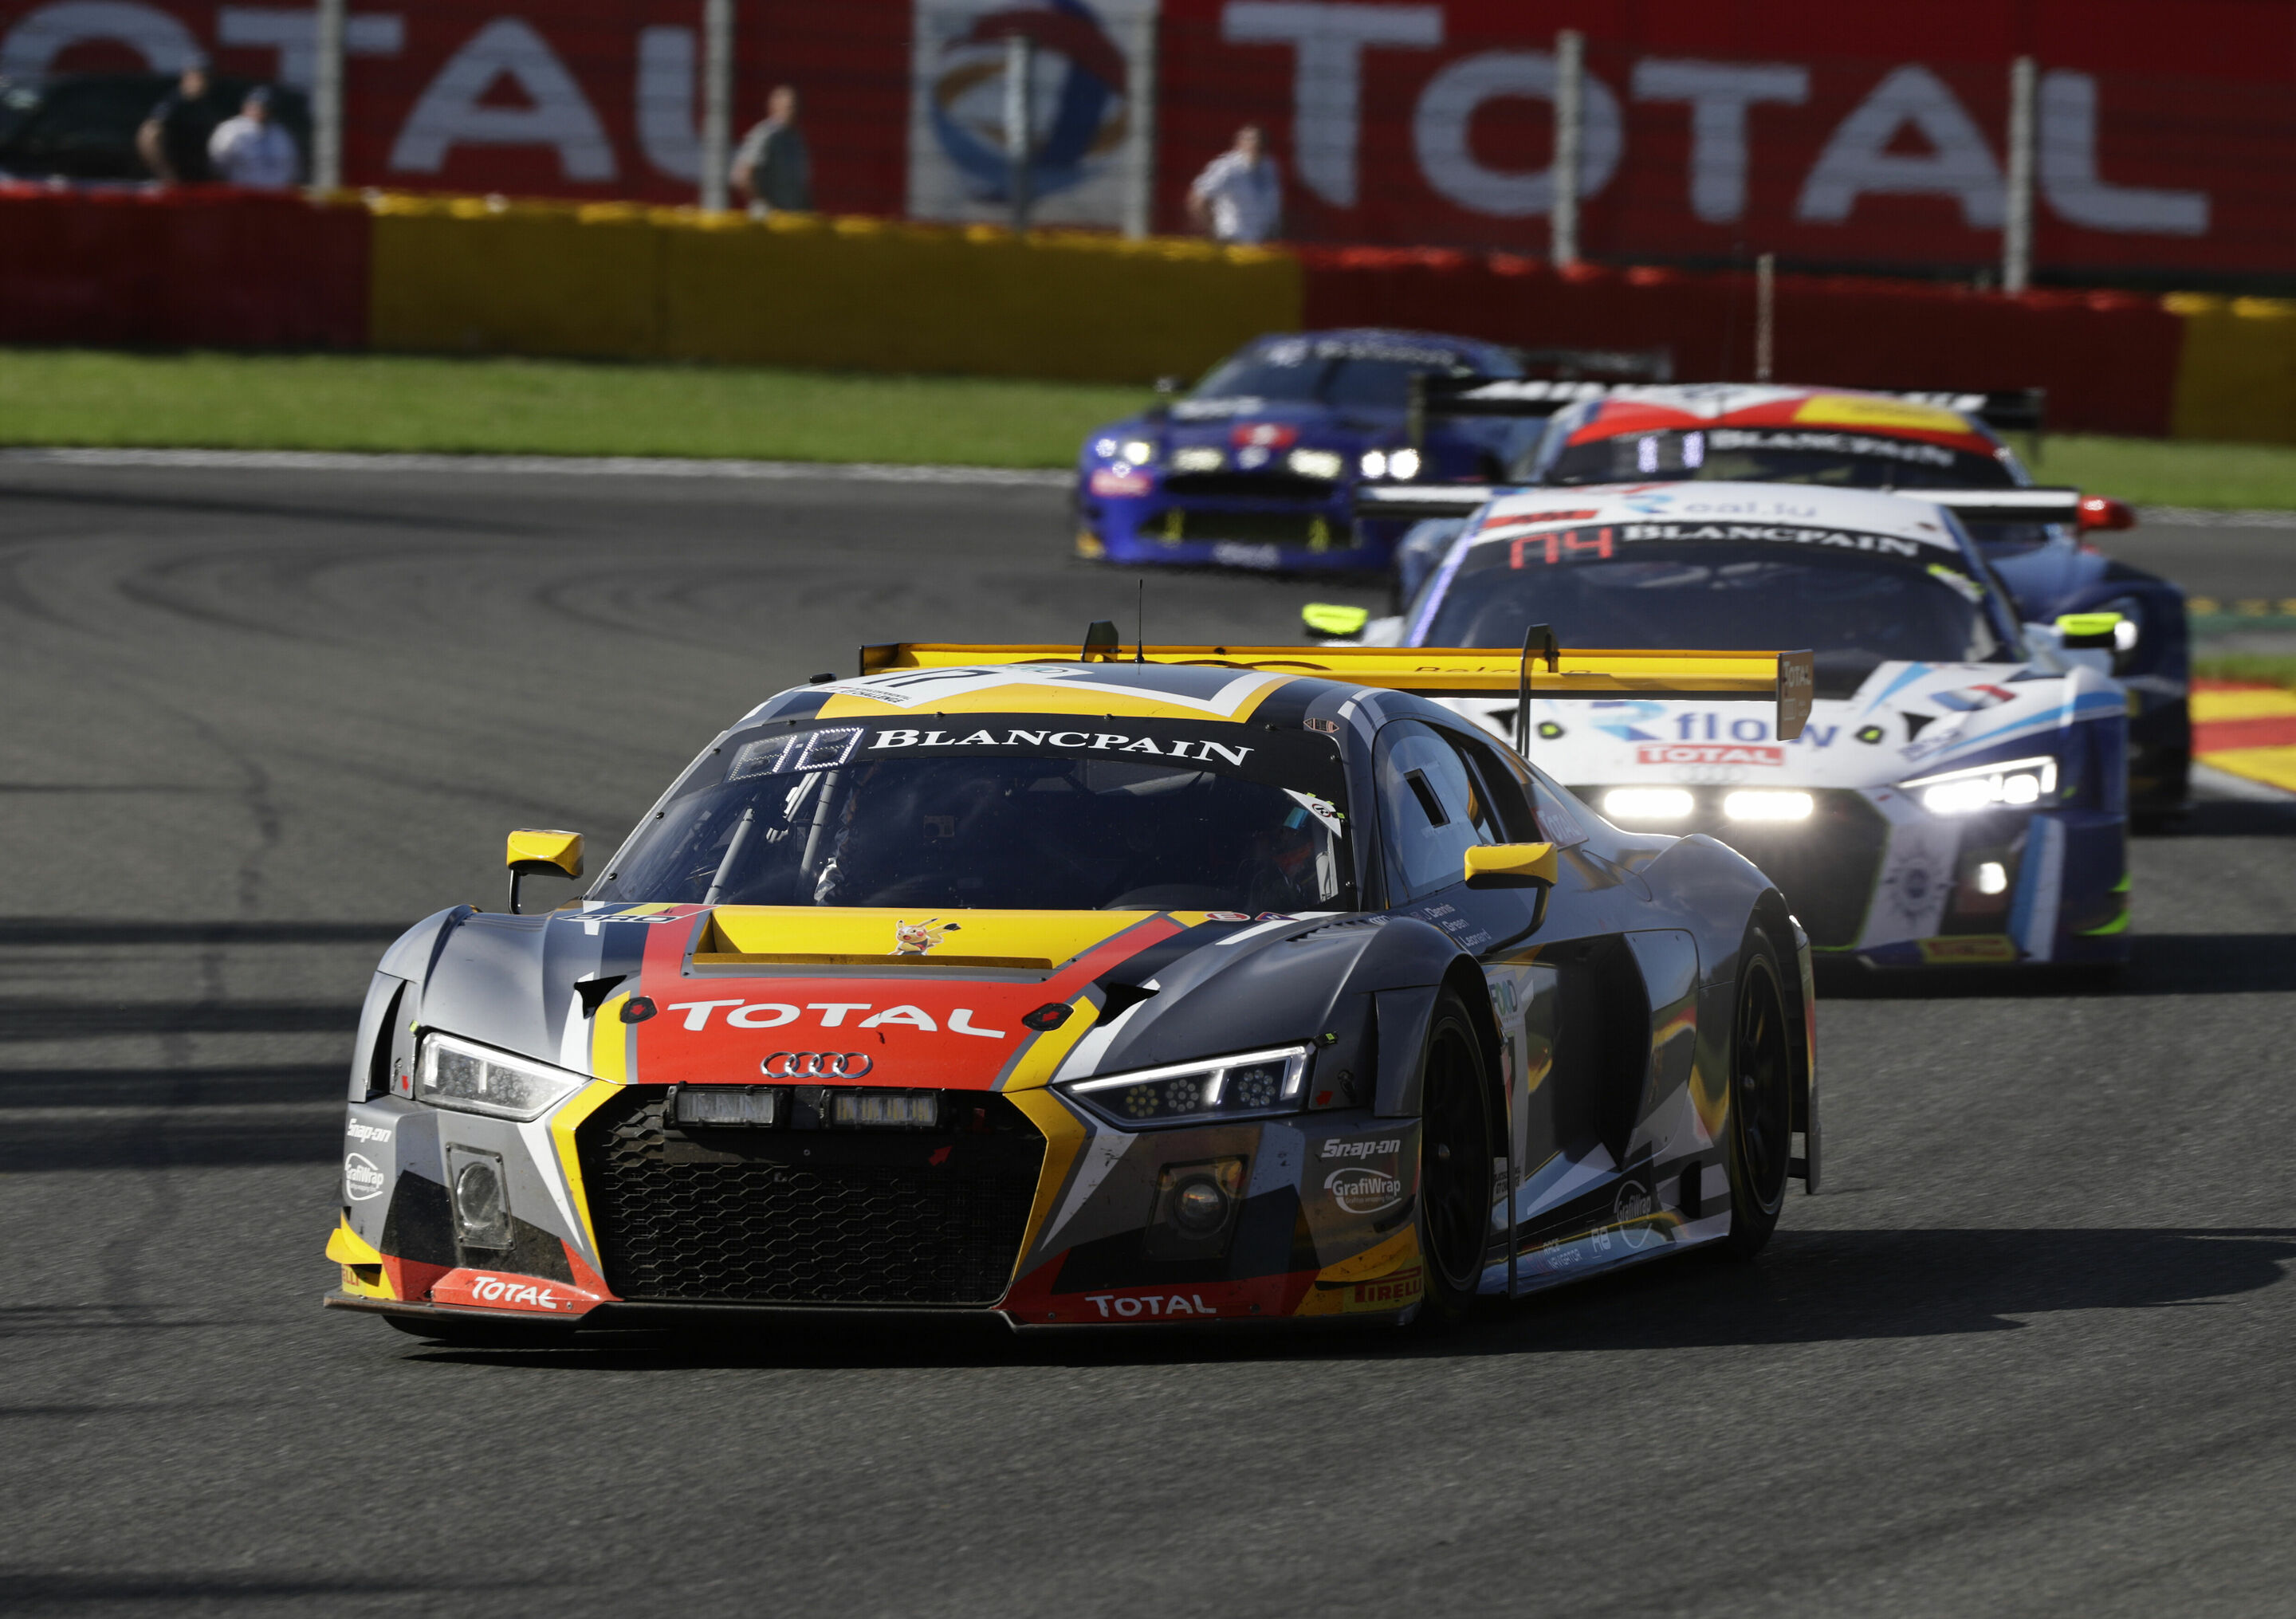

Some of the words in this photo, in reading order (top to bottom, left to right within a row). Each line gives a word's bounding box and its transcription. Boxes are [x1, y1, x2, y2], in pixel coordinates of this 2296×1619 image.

[1223, 2, 2210, 236] TOTAL
[1622, 524, 1918, 557] BLANCPAIN
[868, 728, 1255, 767] BLANCPAIN
[1645, 746, 1776, 764] TOTAL
[1442, 918, 1471, 933] Green
[667, 998, 1006, 1039] TOTAL
[346, 1118, 392, 1143] Snap-on
[1320, 1138, 1402, 1161] Snap-on
[1332, 1177, 1402, 1198] GrafiWrap
[471, 1275, 557, 1310] TOTAL
[1084, 1295, 1218, 1318] TOTAL
